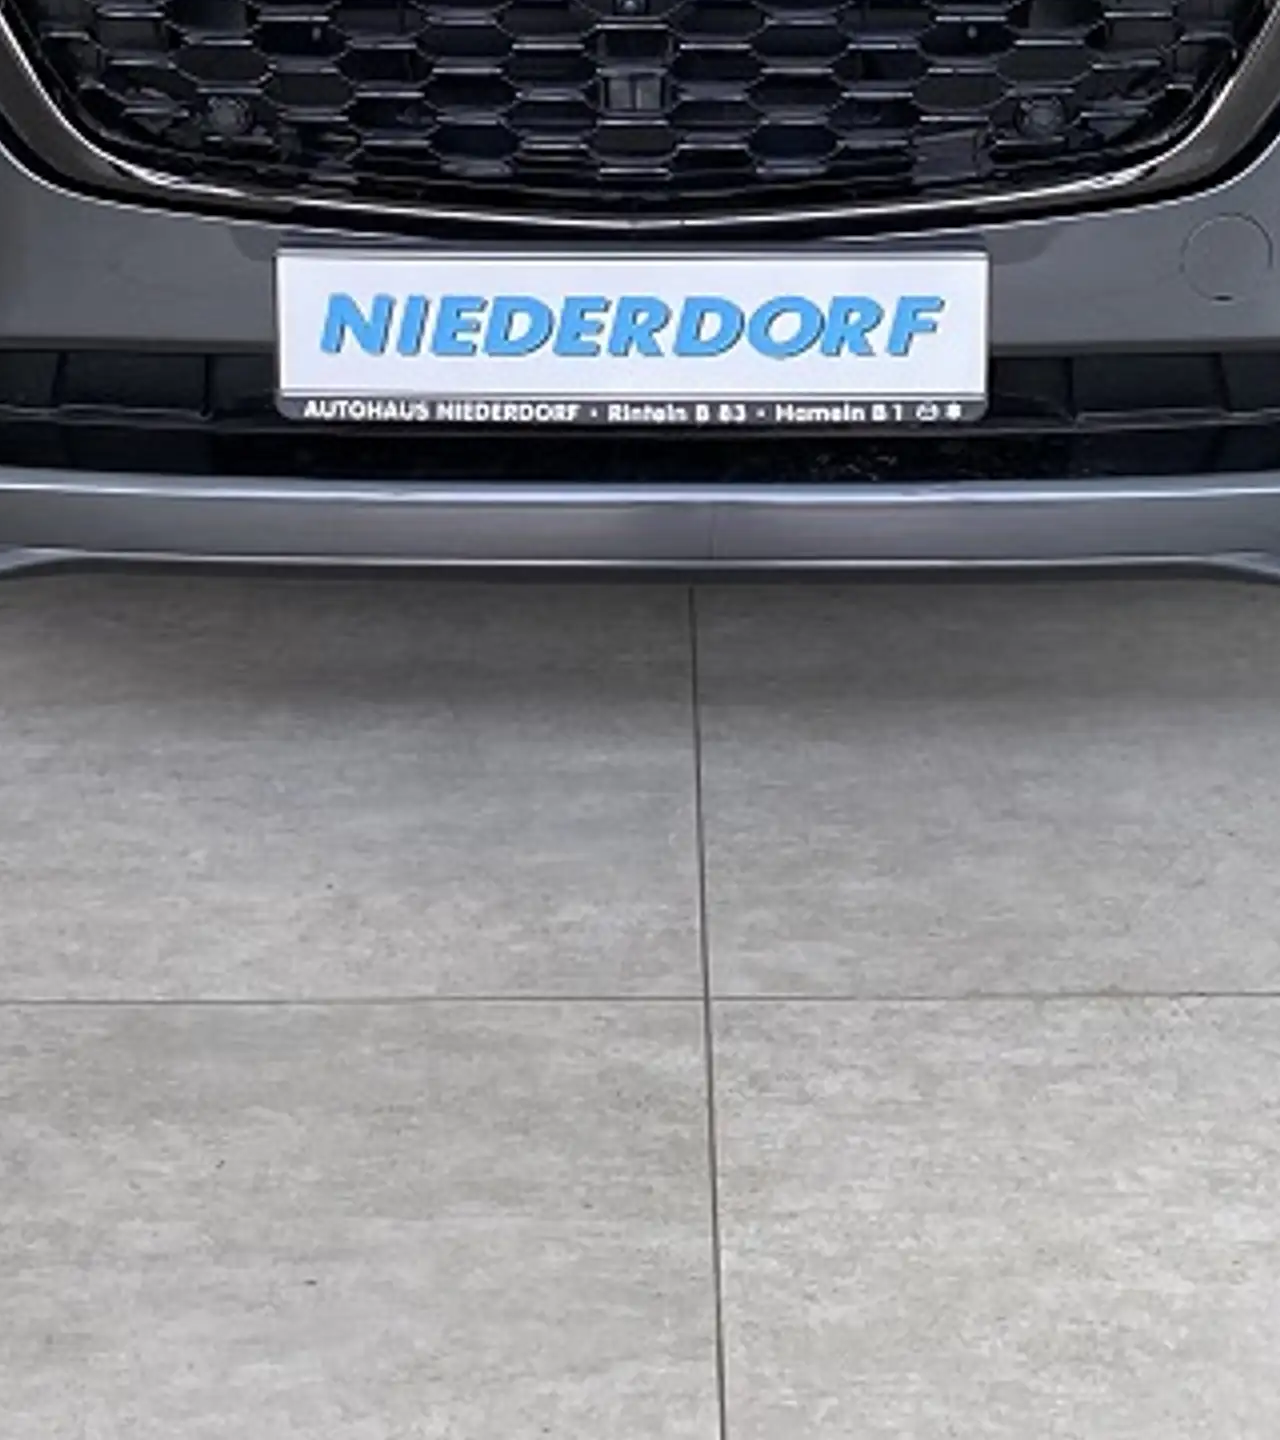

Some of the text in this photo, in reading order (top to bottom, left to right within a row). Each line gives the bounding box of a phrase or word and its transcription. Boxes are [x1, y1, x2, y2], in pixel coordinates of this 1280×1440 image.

[319, 293, 946, 360] NIEDERDORF
[303, 399, 429, 420] AUTOHAUS
[435, 401, 581, 422] NIEDERDORF
